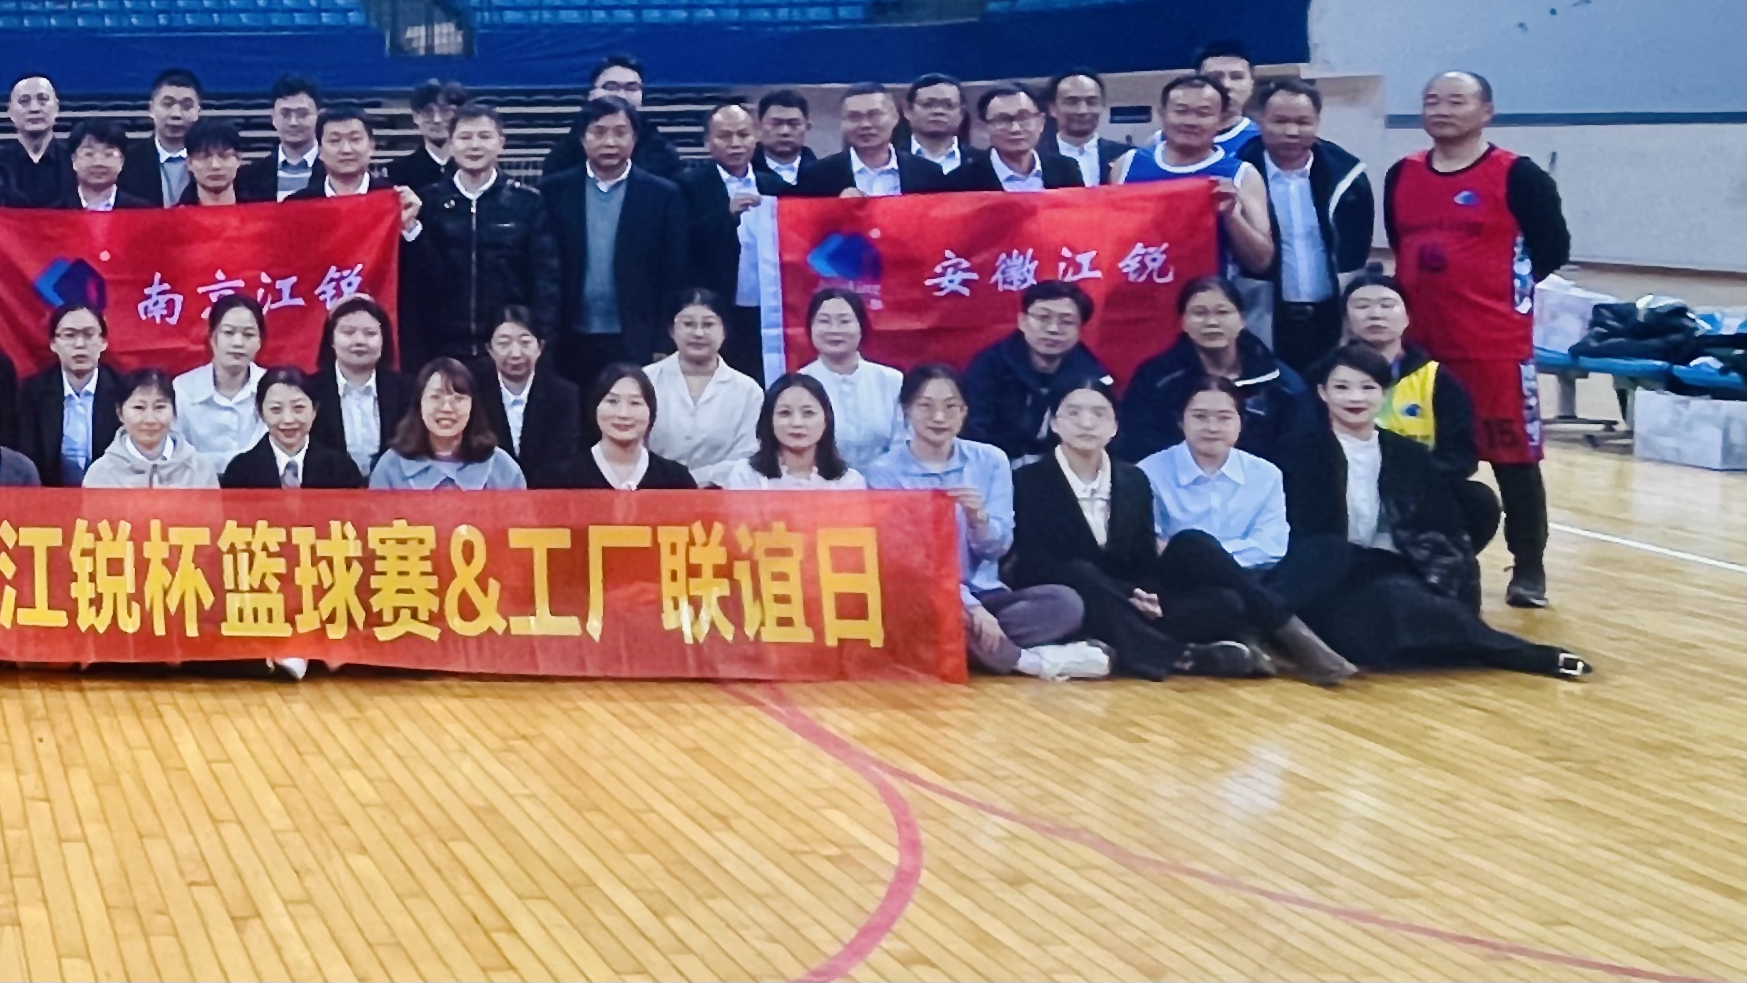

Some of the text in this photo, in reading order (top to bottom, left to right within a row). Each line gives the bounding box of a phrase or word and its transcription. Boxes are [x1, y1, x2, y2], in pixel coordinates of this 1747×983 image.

[138, 263, 363, 325] 南京江锐
[924, 241, 1175, 298] 安徽江锐
[1482, 418, 1520, 450] 15
